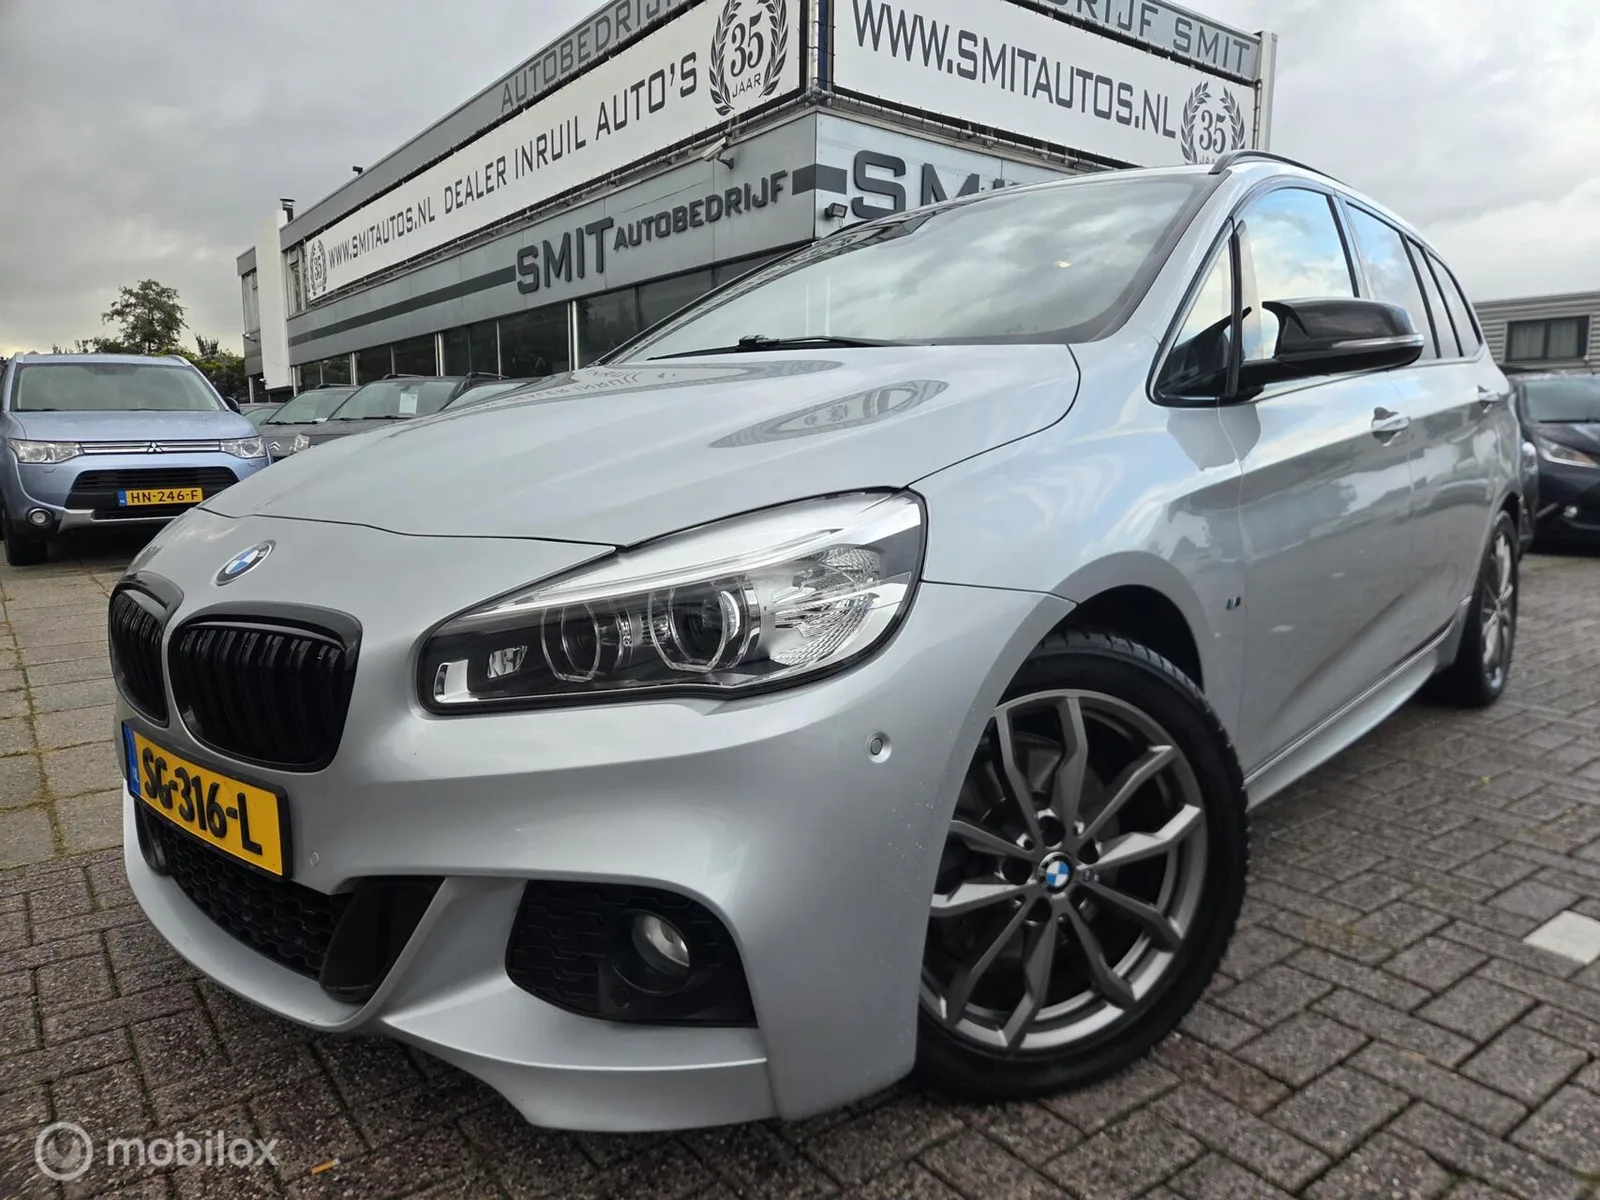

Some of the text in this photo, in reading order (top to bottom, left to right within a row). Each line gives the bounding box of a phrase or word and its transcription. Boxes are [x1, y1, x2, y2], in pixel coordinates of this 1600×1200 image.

[730, 10, 764, 77] 35
[851, 0, 1176, 139] WWW.SMITAUTOS.NL
[1173, 17, 1251, 73] SMIT
[731, 72, 762, 98] JAAR
[328, 51, 697, 269] WWW.SMITAUTOS.NL DEALER INRUIL AUTO'S
[1199, 109, 1226, 154] 35
[517, 169, 788, 294] SMIT AUTOBEDRIJF
[130, 490, 198, 503] HN-246-F
[142, 747, 263, 856] SG-316-L
